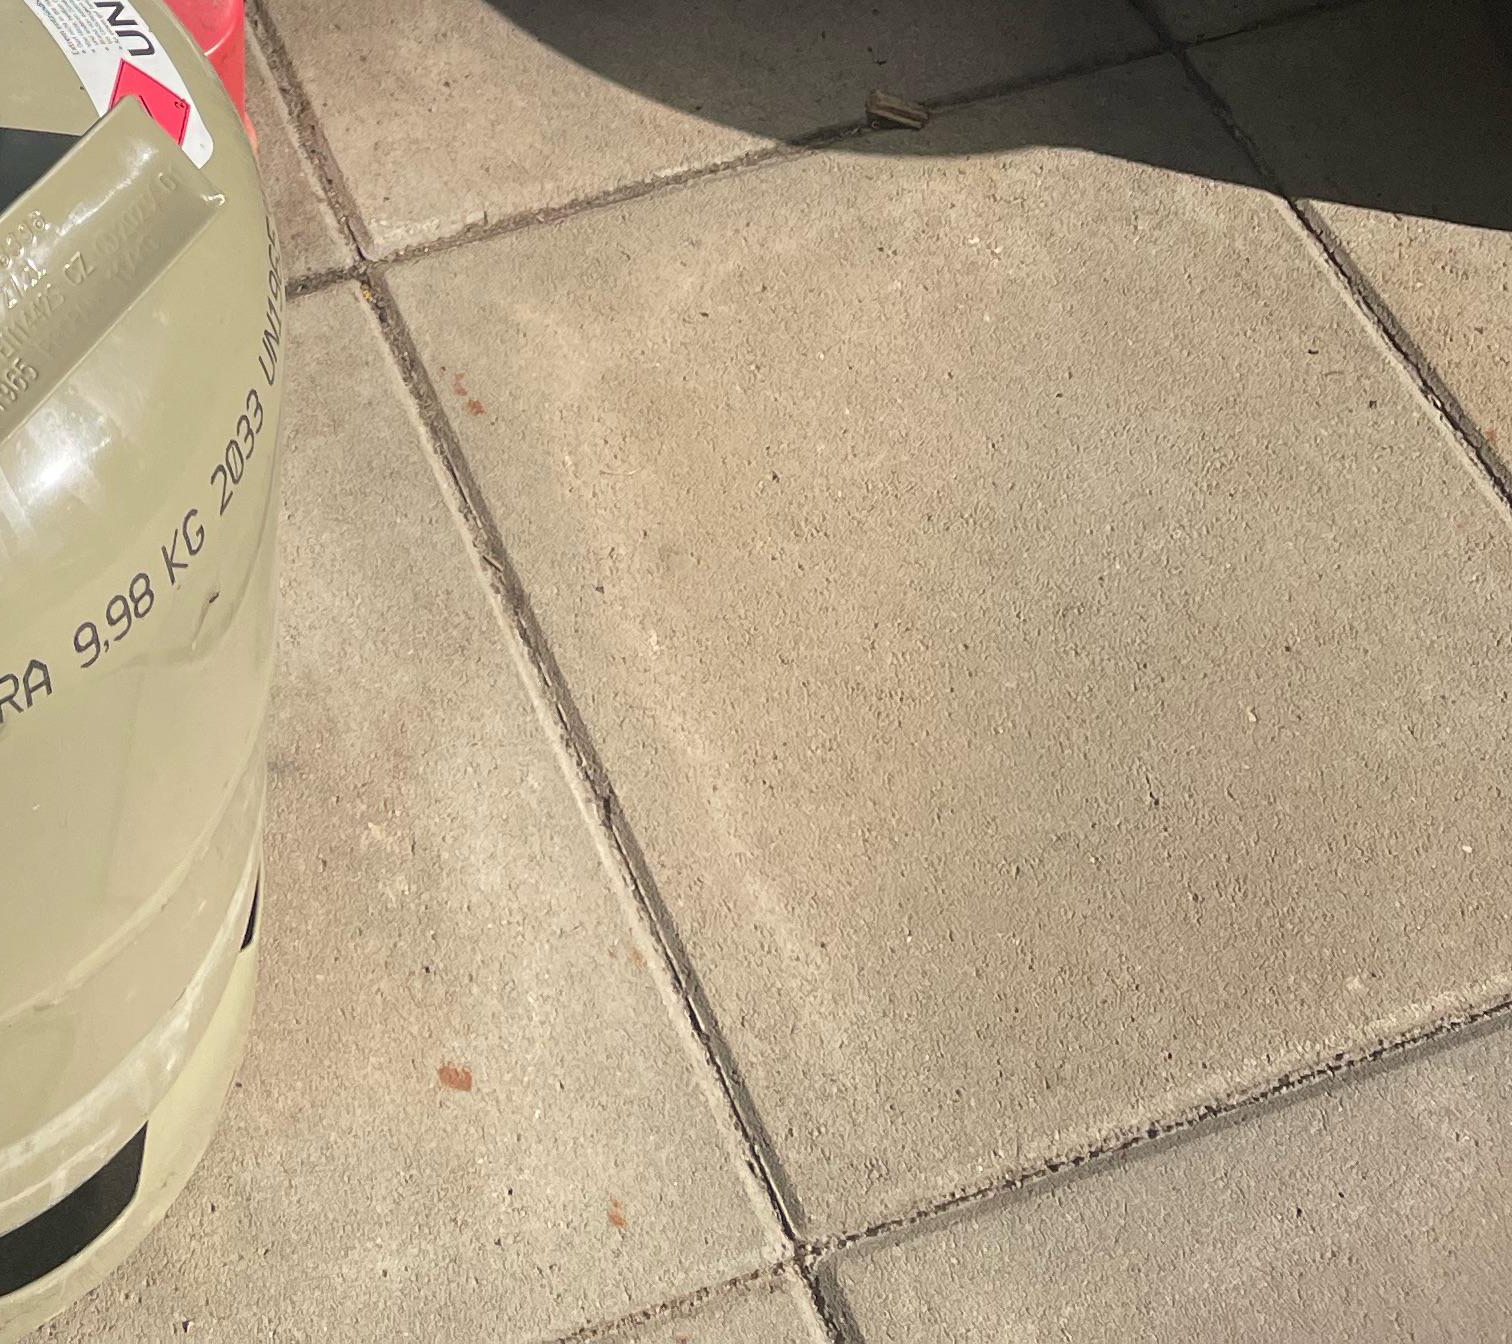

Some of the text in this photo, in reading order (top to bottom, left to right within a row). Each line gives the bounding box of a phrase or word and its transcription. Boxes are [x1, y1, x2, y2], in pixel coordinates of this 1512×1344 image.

[94, 0, 156, 57] UN
[73, 572, 155, 670] 9,98
[160, 507, 206, 586] KG
[209, 388, 265, 516] 2033
